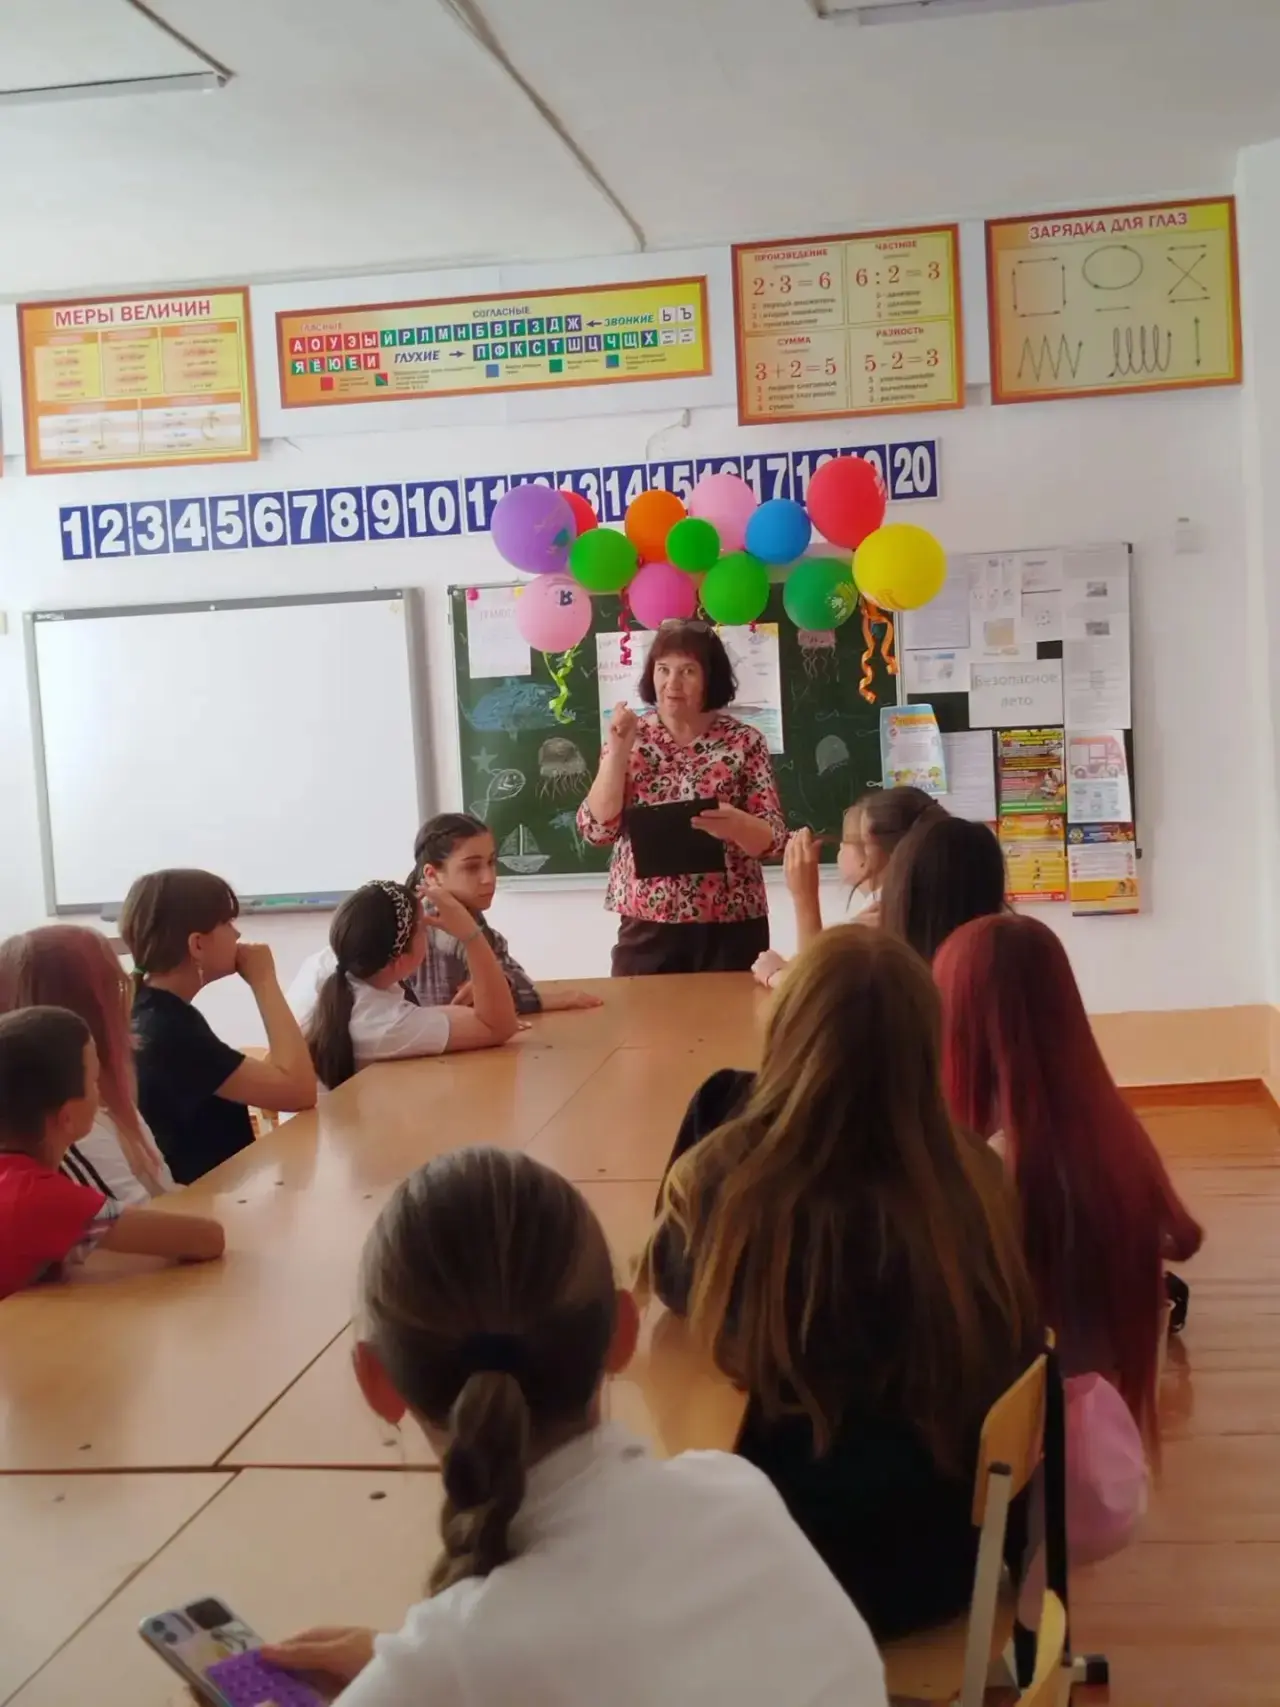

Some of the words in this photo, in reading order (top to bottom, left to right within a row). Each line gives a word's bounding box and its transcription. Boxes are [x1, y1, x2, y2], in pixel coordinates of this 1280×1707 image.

[1029, 219, 1106, 240] ЗАРЯДКА
[1110, 215, 1143, 235] ДЛЯ
[1148, 212, 1188, 228] ГЛАЗ
[54, 308, 115, 327] МЕРЫ
[120, 300, 211, 322] ВЕЛИЧИН
[472, 306, 532, 318] СОГЛАСНЫЕ
[604, 313, 655, 327] ЗВОНКИЕ
[777, 336, 811, 346] СУММА
[394, 350, 440, 364] ГЛУХИЕ
[63, 510, 84, 555] 1
[98, 508, 126, 554] 2
[136, 505, 165, 551] 3
[174, 502, 206, 547] 4
[216, 499, 244, 545] 5
[253, 496, 284, 543] 6
[292, 494, 318, 540] 7
[330, 491, 360, 538] 8
[371, 488, 400, 536] 9
[408, 485, 456, 533] 10
[746, 457, 788, 504] 17
[893, 444, 932, 495] 20
